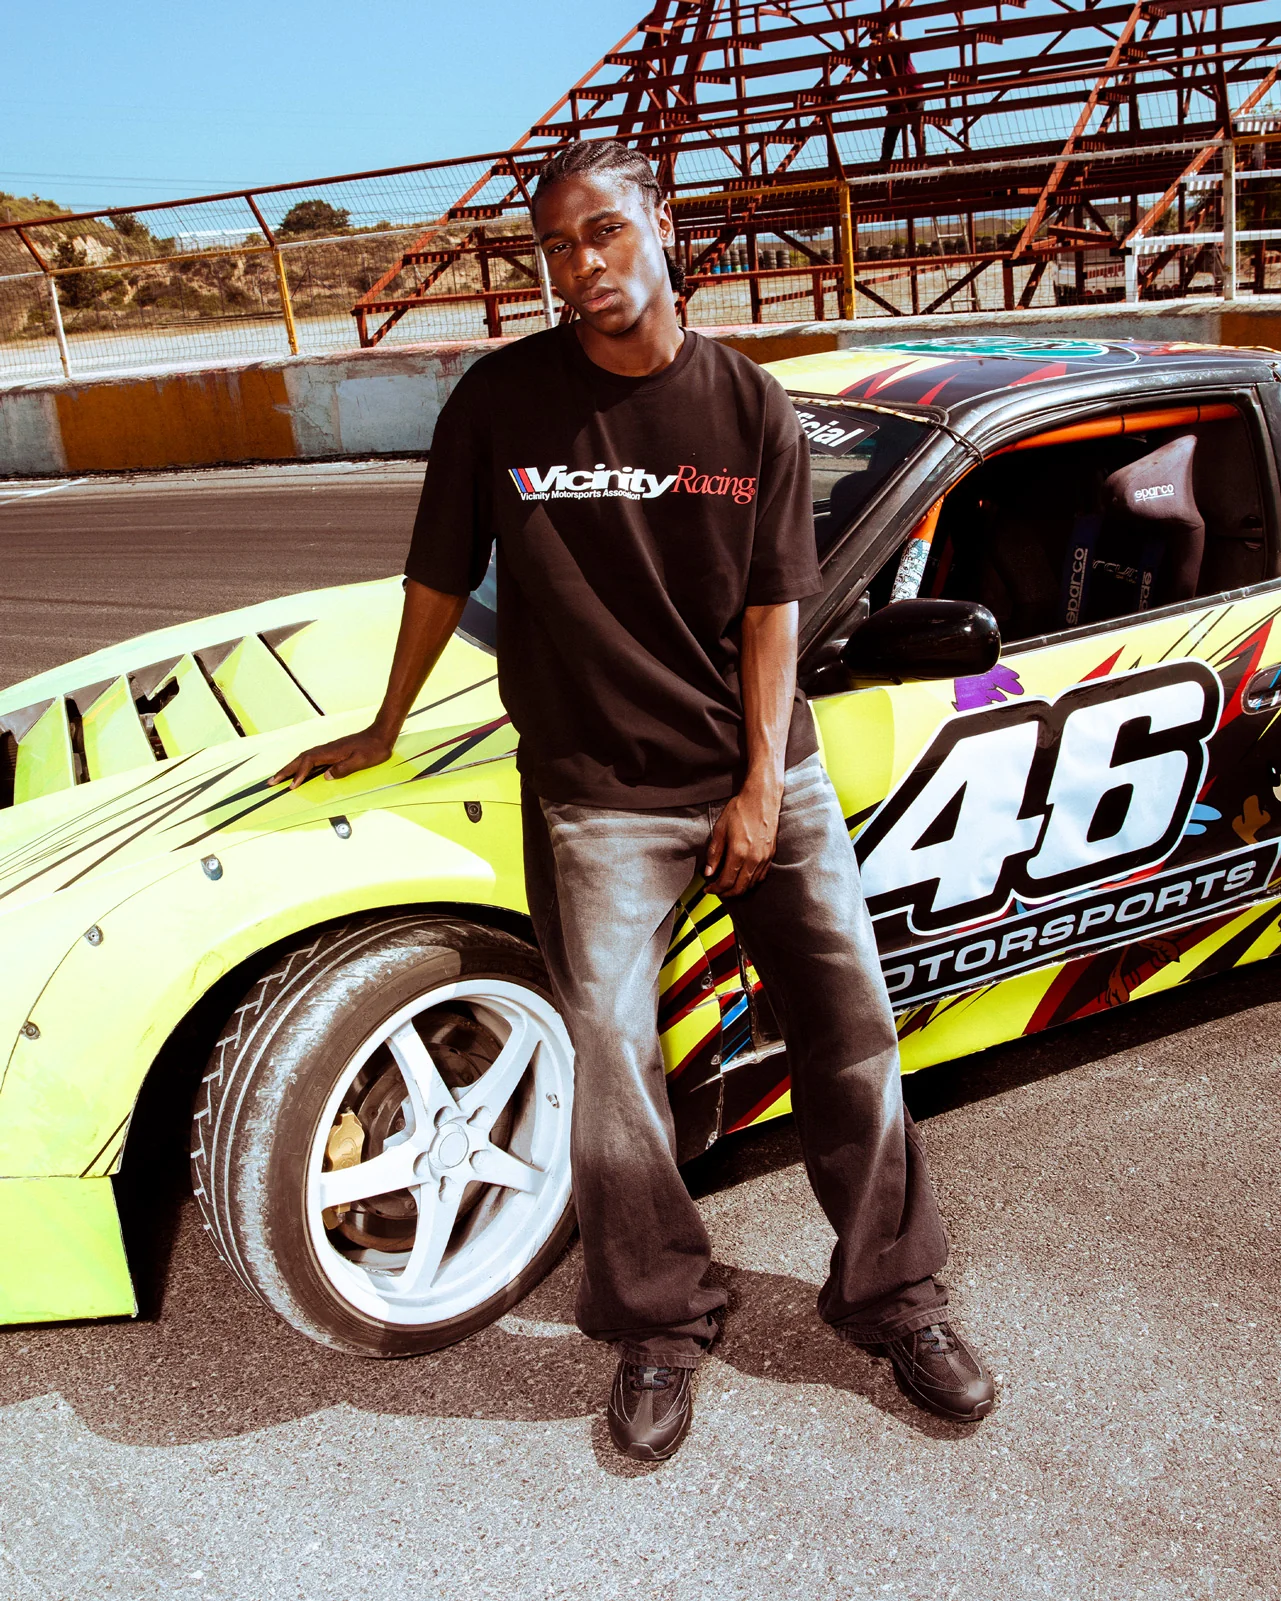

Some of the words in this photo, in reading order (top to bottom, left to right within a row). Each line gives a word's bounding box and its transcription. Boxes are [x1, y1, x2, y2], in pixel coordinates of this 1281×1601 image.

[520, 492, 551, 501] Vicinity
[551, 490, 602, 500] Motorsports
[524, 463, 678, 499] Vicinity
[1134, 483, 1174, 502] sparco
[1065, 547, 1087, 625] sparco
[860, 680, 1205, 913] 46
[882, 860, 1257, 993] OTORSPORTS
